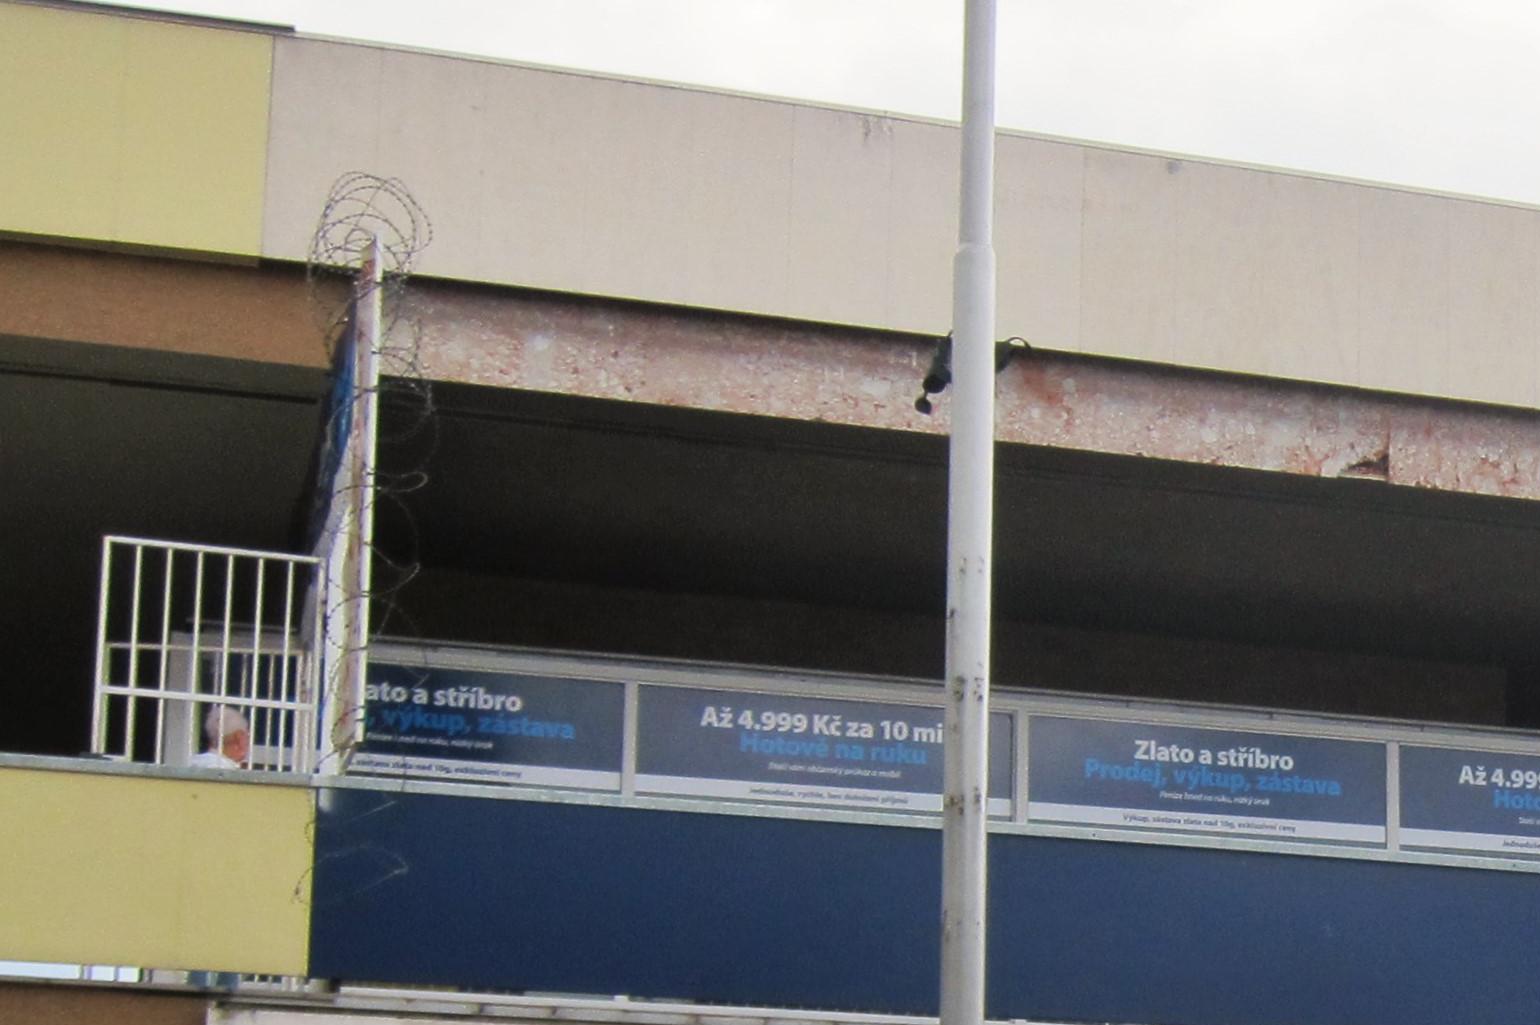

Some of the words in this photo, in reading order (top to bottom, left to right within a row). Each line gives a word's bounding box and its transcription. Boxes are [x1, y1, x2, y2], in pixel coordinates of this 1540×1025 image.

[365, 682, 407, 702] ato
[412, 687, 428, 704] a
[434, 686, 522, 711] stříbro
[381, 705, 470, 734] výkup,
[478, 713, 577, 739] zástava
[701, 706, 733, 729] Až
[738, 709, 808, 732] 4.999
[813, 714, 841, 736] Kč
[846, 723, 873, 738] za
[881, 720, 907, 740] 10
[913, 723, 943, 743] mi
[835, 743, 865, 760] na
[872, 743, 927, 764] ruku
[1134, 739, 1194, 763] Zlato
[1199, 750, 1212, 765] a
[1217, 747, 1294, 771] stříbro
[1084, 758, 1167, 788] Prodej,
[1172, 766, 1249, 791] výkup,
[1257, 772, 1342, 796] zástava
[1459, 765, 1487, 786] Až
